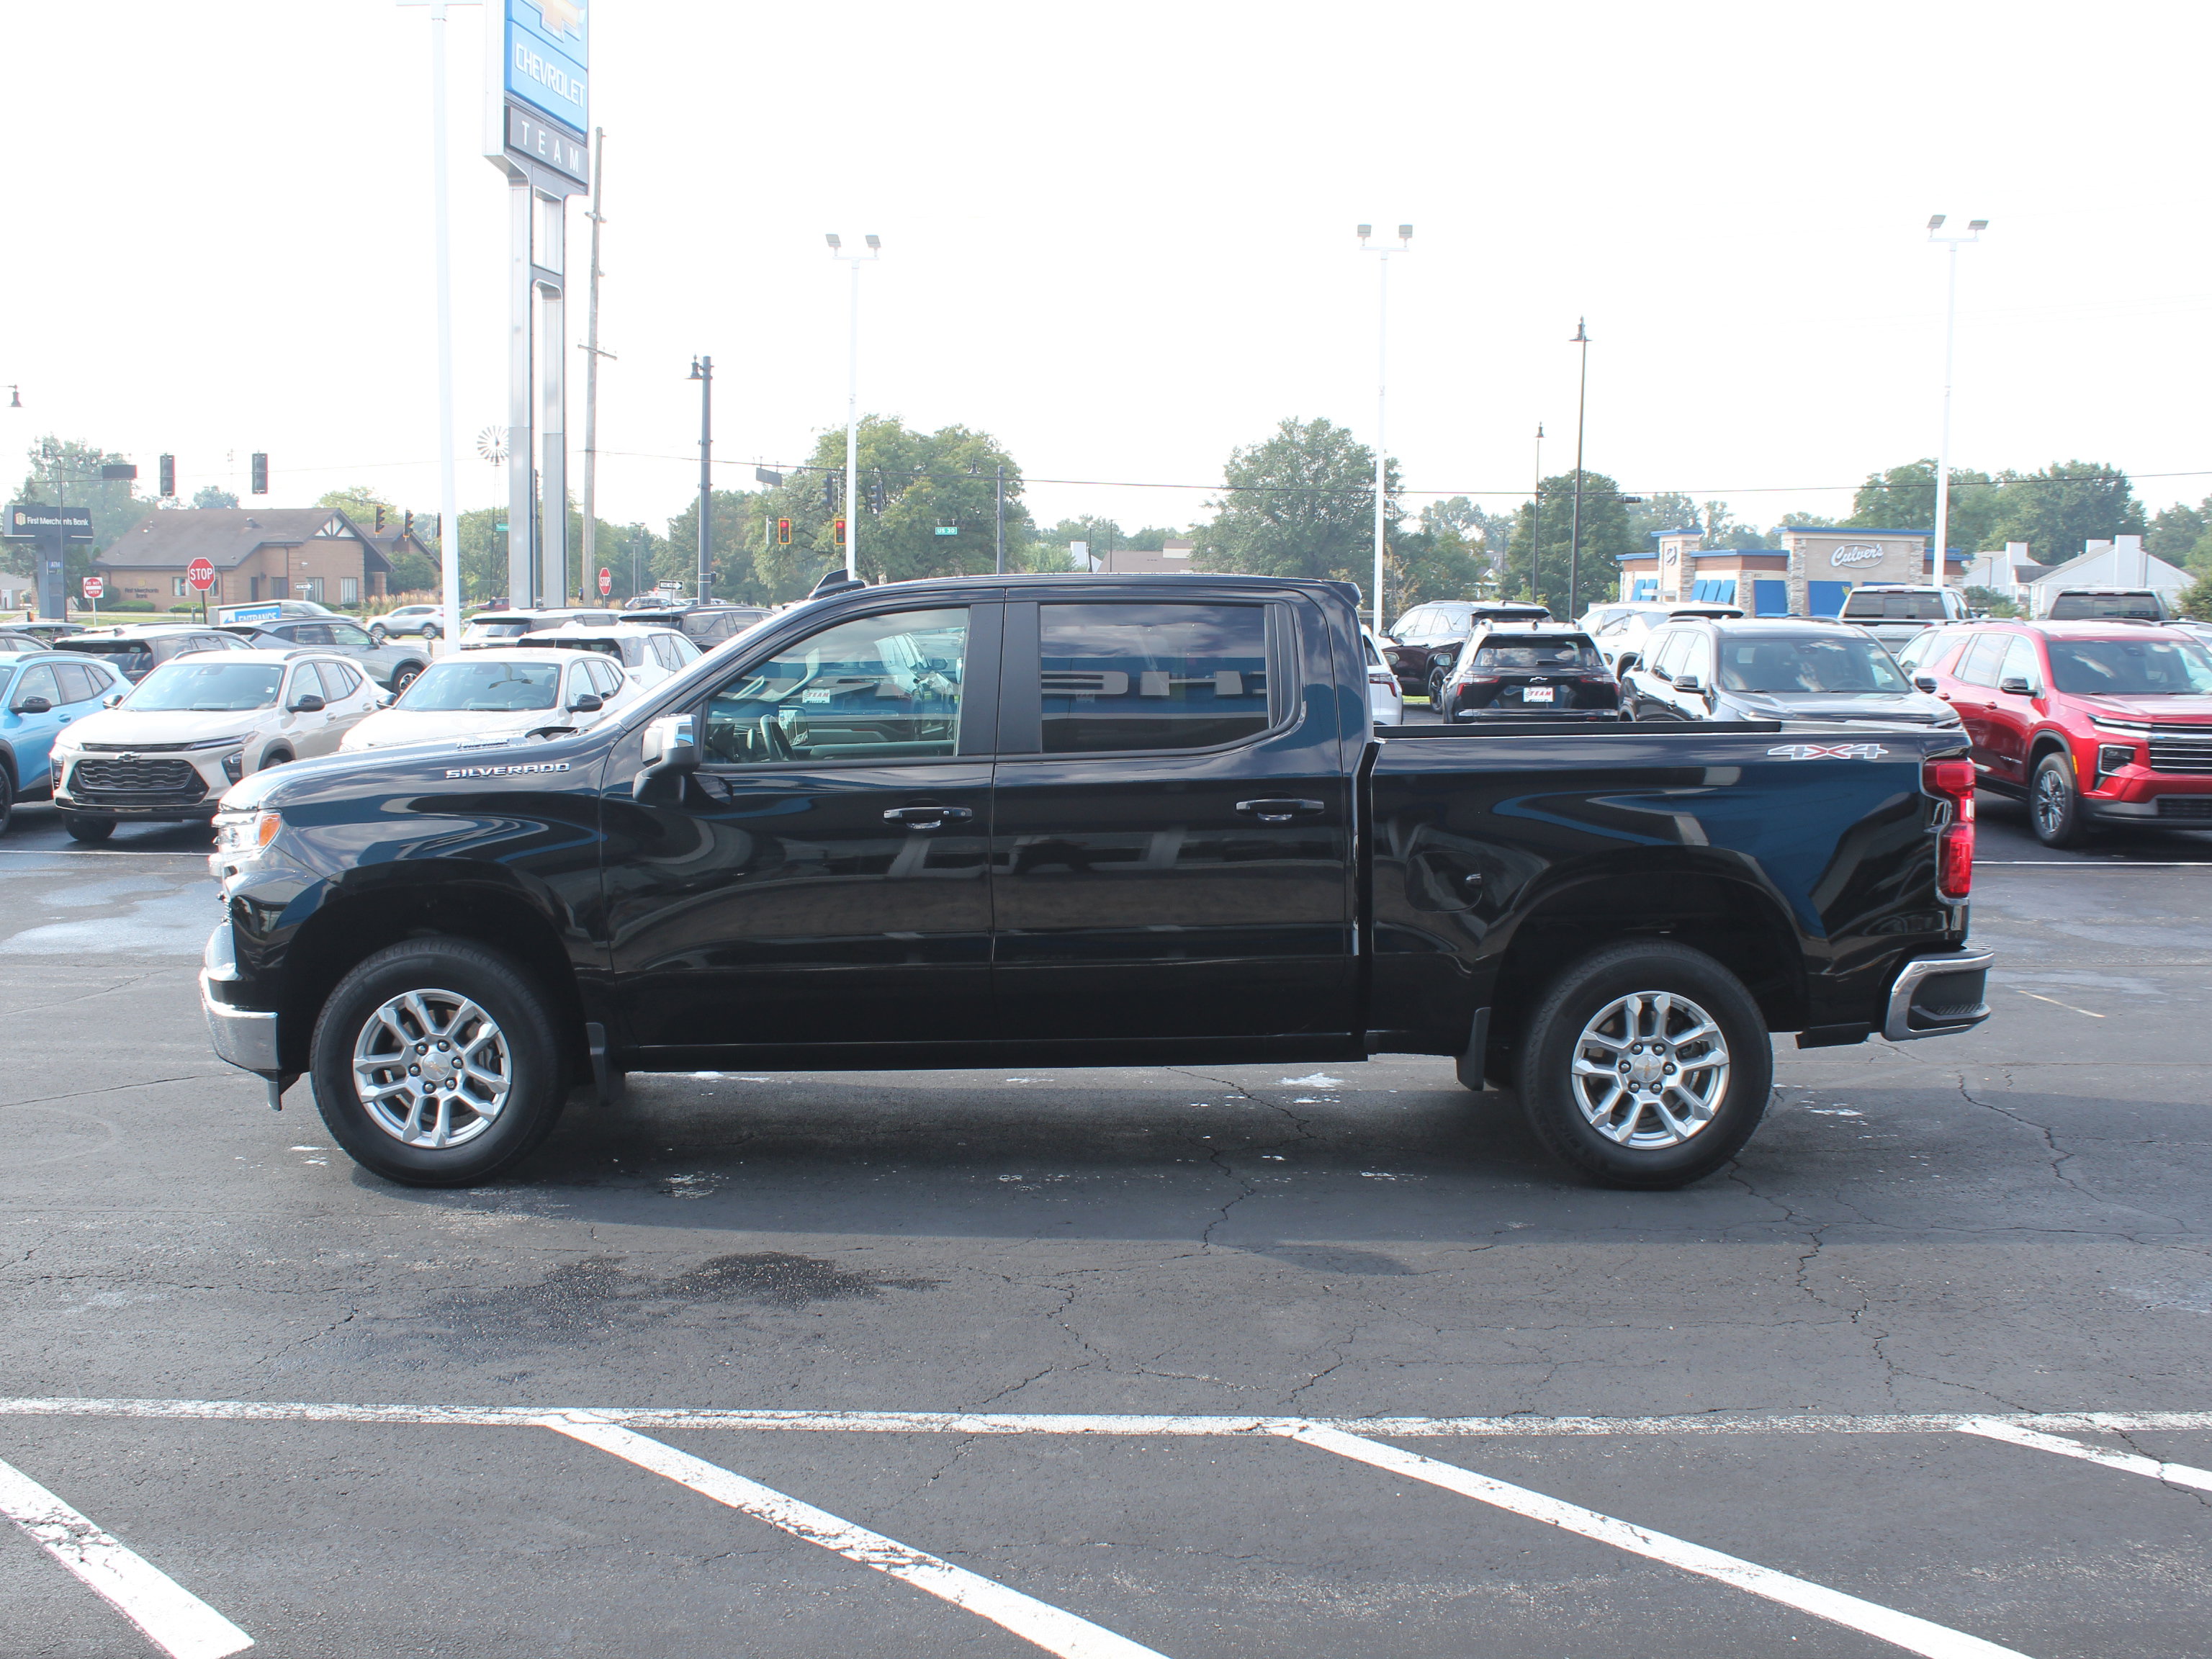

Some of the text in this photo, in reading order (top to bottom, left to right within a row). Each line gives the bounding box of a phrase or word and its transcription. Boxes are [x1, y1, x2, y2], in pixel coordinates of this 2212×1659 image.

[515, 42, 585, 108] CHEVROLET
[521, 120, 579, 173] TEAM
[1830, 544, 1884, 567] Culver's
[190, 567, 214, 580] STOP
[600, 576, 611, 587] STOP
[446, 763, 571, 779] SILVERADO
